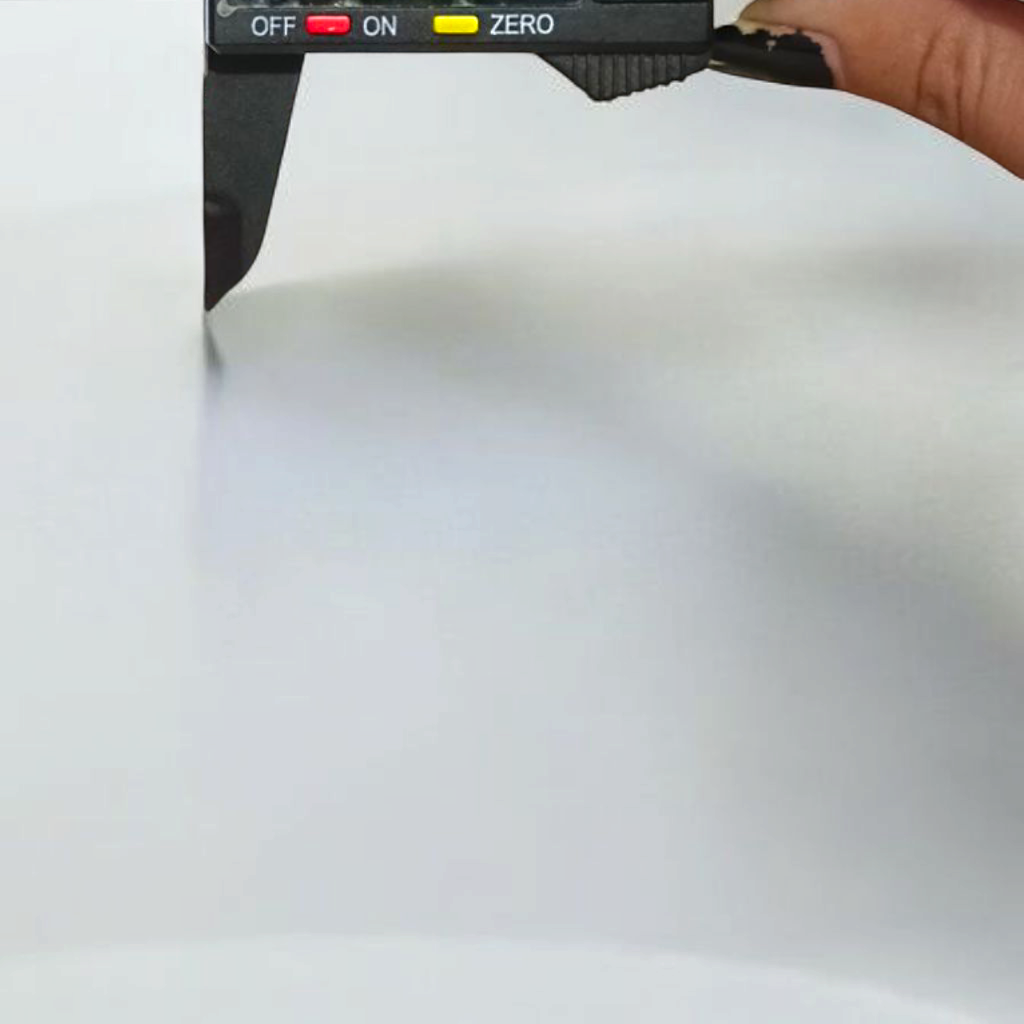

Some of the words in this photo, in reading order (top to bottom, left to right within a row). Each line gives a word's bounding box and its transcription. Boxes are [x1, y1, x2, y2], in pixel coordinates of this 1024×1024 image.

[251, 16, 297, 37] OFF
[363, 16, 398, 36] ON
[490, 13, 555, 36] ZERO
